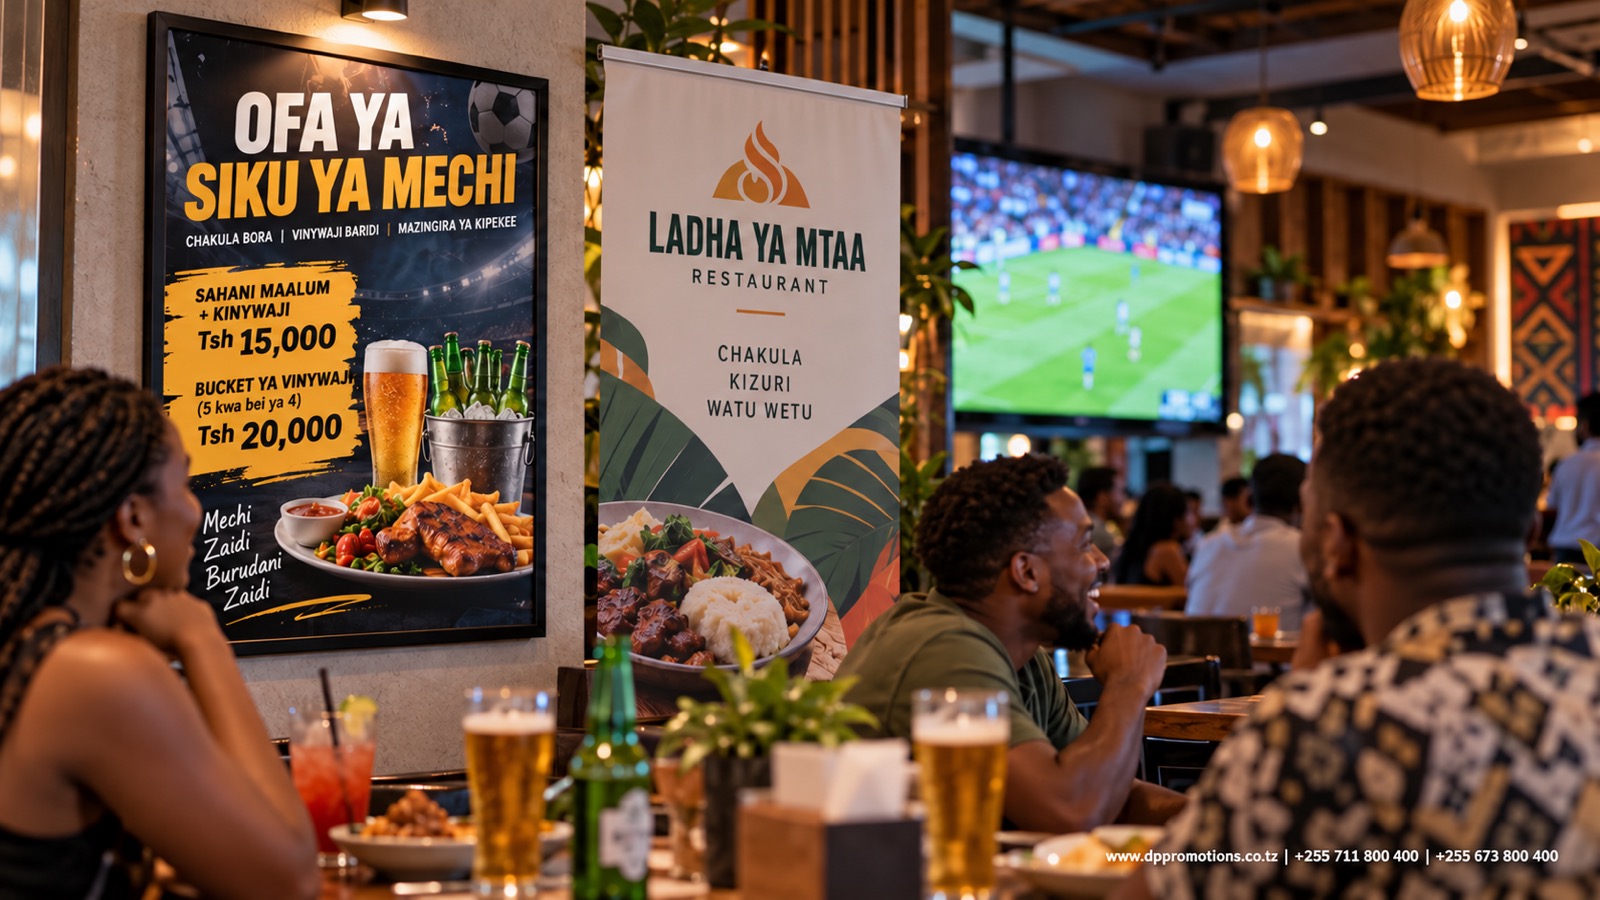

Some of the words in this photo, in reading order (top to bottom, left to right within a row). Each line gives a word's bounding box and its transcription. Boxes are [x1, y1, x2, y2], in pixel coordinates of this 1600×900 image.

[234, 91, 339, 154] OFA
[349, 92, 414, 151] YA
[184, 160, 300, 222] SIKU
[310, 157, 371, 213] YA
[382, 153, 517, 210] MECHI
[292, 226, 343, 241] VINYWAJI
[345, 223, 379, 237] BARIDI
[398, 219, 456, 234] MAZINGIRA
[459, 218, 473, 230] YA
[475, 215, 517, 229] KIPEKEE
[186, 232, 240, 248] CHAKULA
[243, 230, 273, 244] BORA
[649, 210, 744, 261] LADHA
[752, 222, 787, 265] YA
[796, 226, 866, 272] MTAA
[195, 284, 255, 303] SAHANI
[260, 280, 330, 298] MAALUM
[692, 269, 828, 295] RESTAURANT
[200, 309, 209, 320] +
[213, 302, 290, 321] KINYWAJI
[198, 329, 233, 350] Tsh
[240, 323, 336, 358] 15,000
[717, 344, 802, 366] CHAKULA
[195, 377, 254, 396] BUCKET
[258, 375, 278, 391] YA
[730, 373, 790, 392] KIZURI
[197, 401, 211, 418] (5
[215, 399, 241, 414] kwa
[245, 397, 265, 411] bei
[269, 399, 283, 412] ya
[288, 393, 301, 409] 4)
[707, 400, 756, 418] WATU
[764, 402, 812, 420] WETU
[198, 423, 234, 445] Tsh
[240, 413, 342, 451] 20,000
[203, 503, 251, 534] Mechi
[203, 529, 251, 562] Zaidi
[206, 552, 282, 590] Burudani
[223, 578, 270, 611] Zaidi
